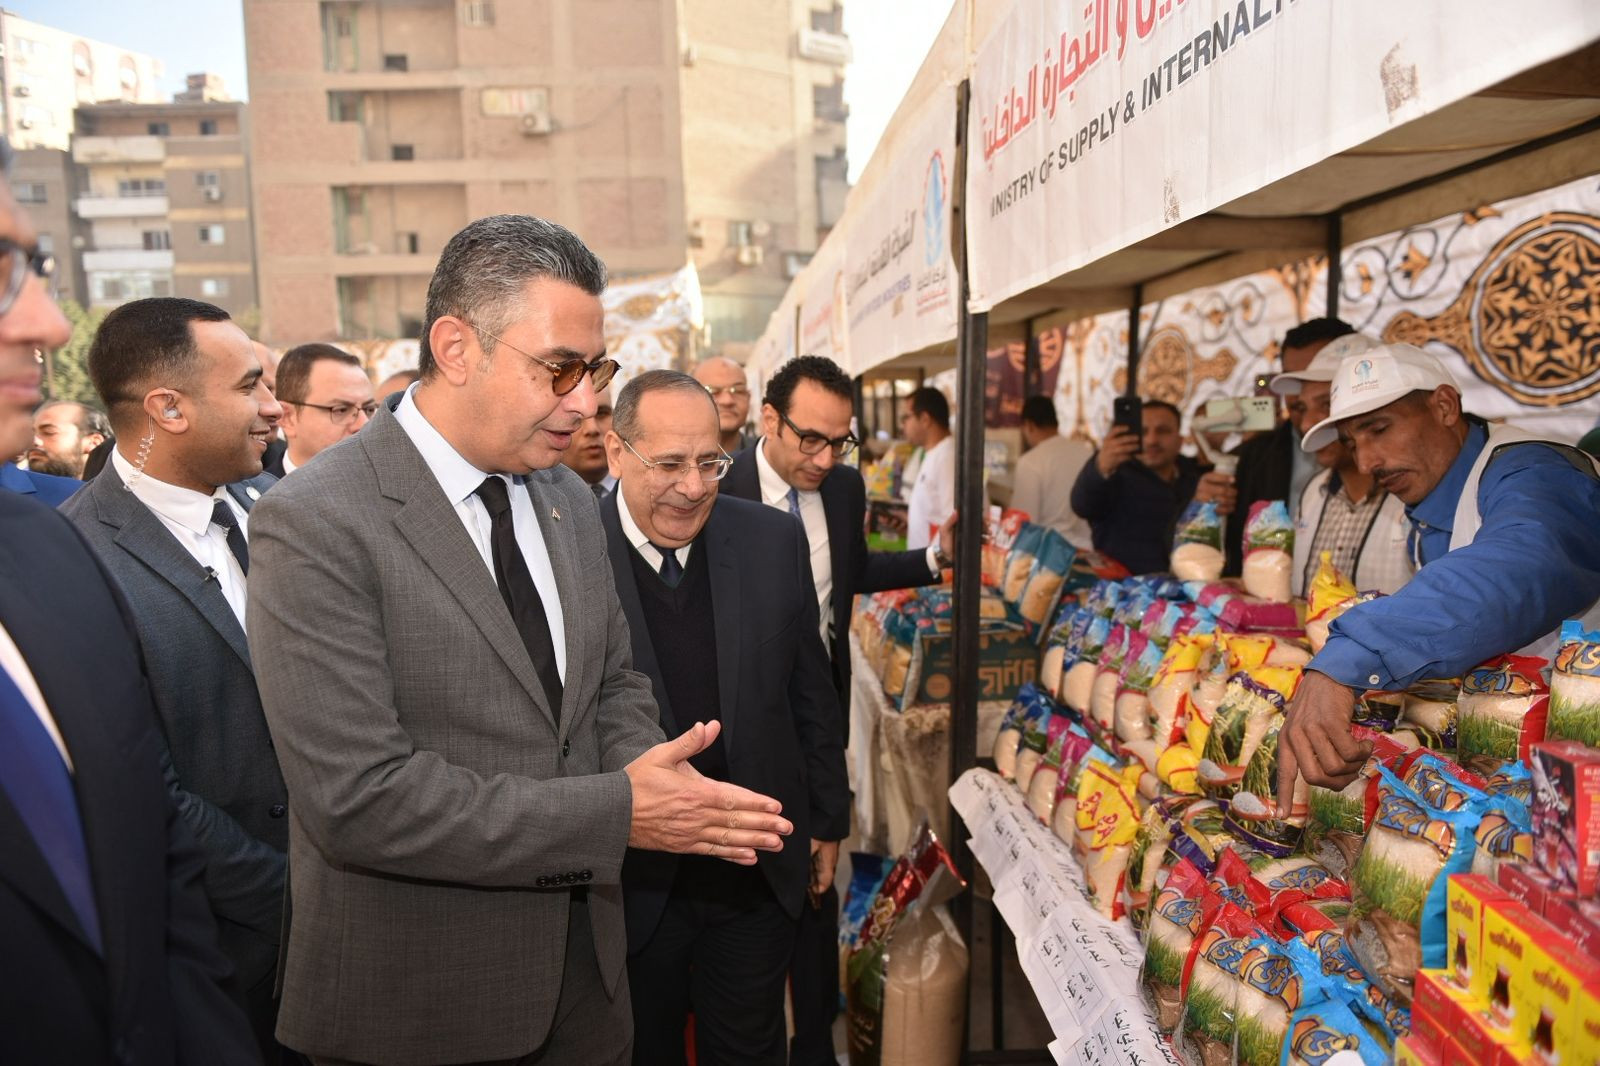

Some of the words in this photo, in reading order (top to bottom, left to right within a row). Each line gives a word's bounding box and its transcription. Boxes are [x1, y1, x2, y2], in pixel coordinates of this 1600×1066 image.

[982, 63, 1037, 170] الداخلية
[1039, 152, 1054, 184] OF
[1058, 101, 1120, 170] SUPPLY
[1123, 90, 1135, 124] &
[1142, 0, 1272, 111] INTERNAL
[1041, 0, 1111, 120] التجارة
